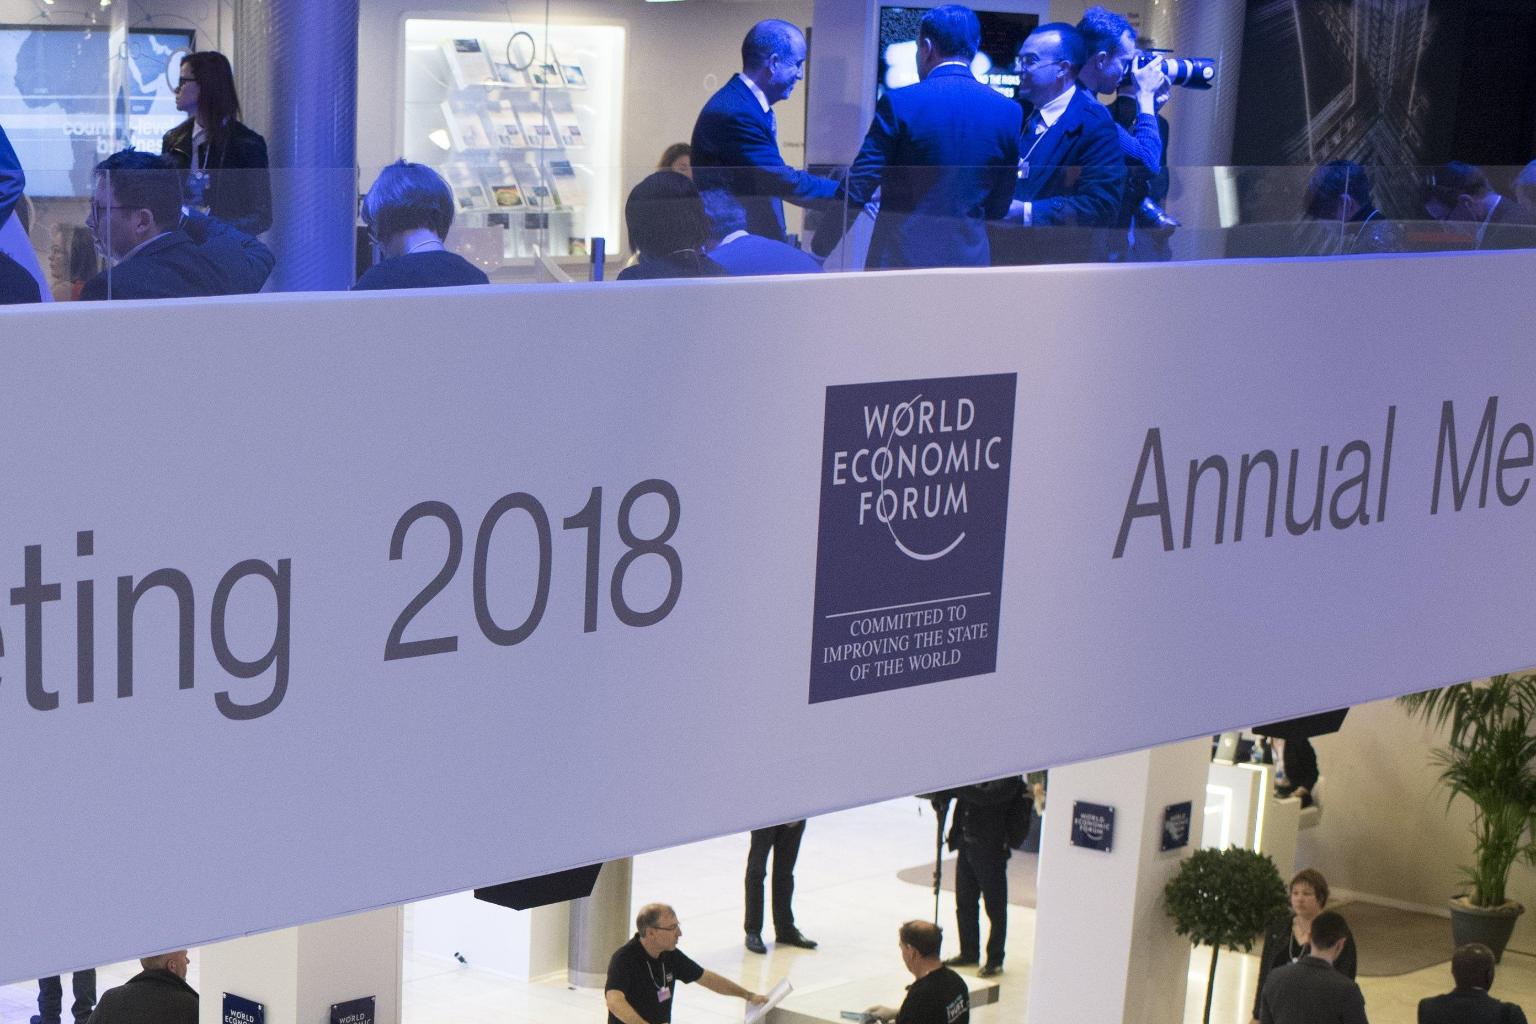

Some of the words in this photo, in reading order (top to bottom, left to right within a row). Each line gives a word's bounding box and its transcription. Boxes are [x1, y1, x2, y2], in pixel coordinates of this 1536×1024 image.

[864, 398, 975, 440] WORLD
[833, 436, 1002, 485] ECONOMIC
[1112, 405, 1397, 560] Annual
[1430, 395, 1535, 515] Me
[859, 481, 968, 525] FORUM
[383, 478, 684, 662] 2018
[850, 607, 943, 637] COMMITTED
[948, 604, 967, 622] TO
[823, 635, 910, 664] IMPROVING
[914, 631, 943, 649] THE
[947, 622, 989, 645] STATE
[850, 664, 871, 682] OF
[874, 658, 904, 678] THE
[909, 649, 961, 672] WORLD
[230, 1009, 255, 1023] WORLD
[339, 1013, 365, 1024] WORLD
